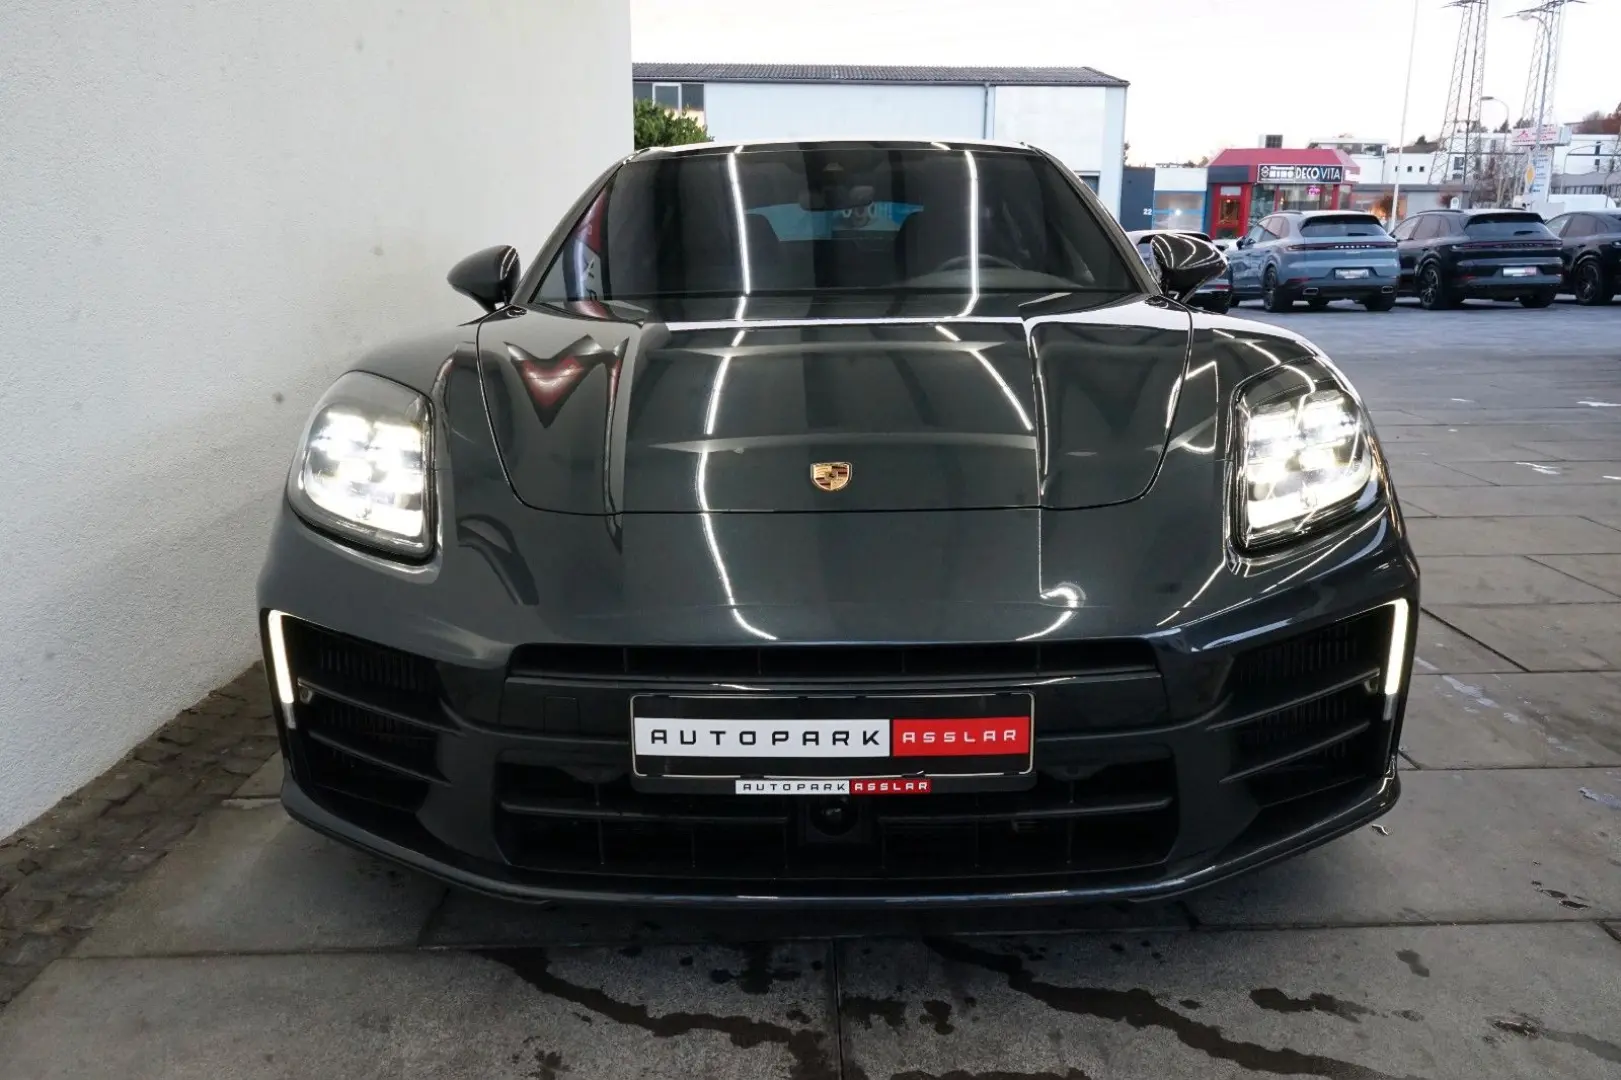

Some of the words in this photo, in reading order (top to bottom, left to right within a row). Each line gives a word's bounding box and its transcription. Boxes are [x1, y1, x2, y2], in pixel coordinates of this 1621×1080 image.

[1143, 208, 1153, 216] 22
[650, 729, 880, 746] AUTOPARK
[902, 729, 1017, 744] ASSLAR
[743, 783, 846, 792] AUTOPARK
[854, 782, 928, 791] ASSLAR
